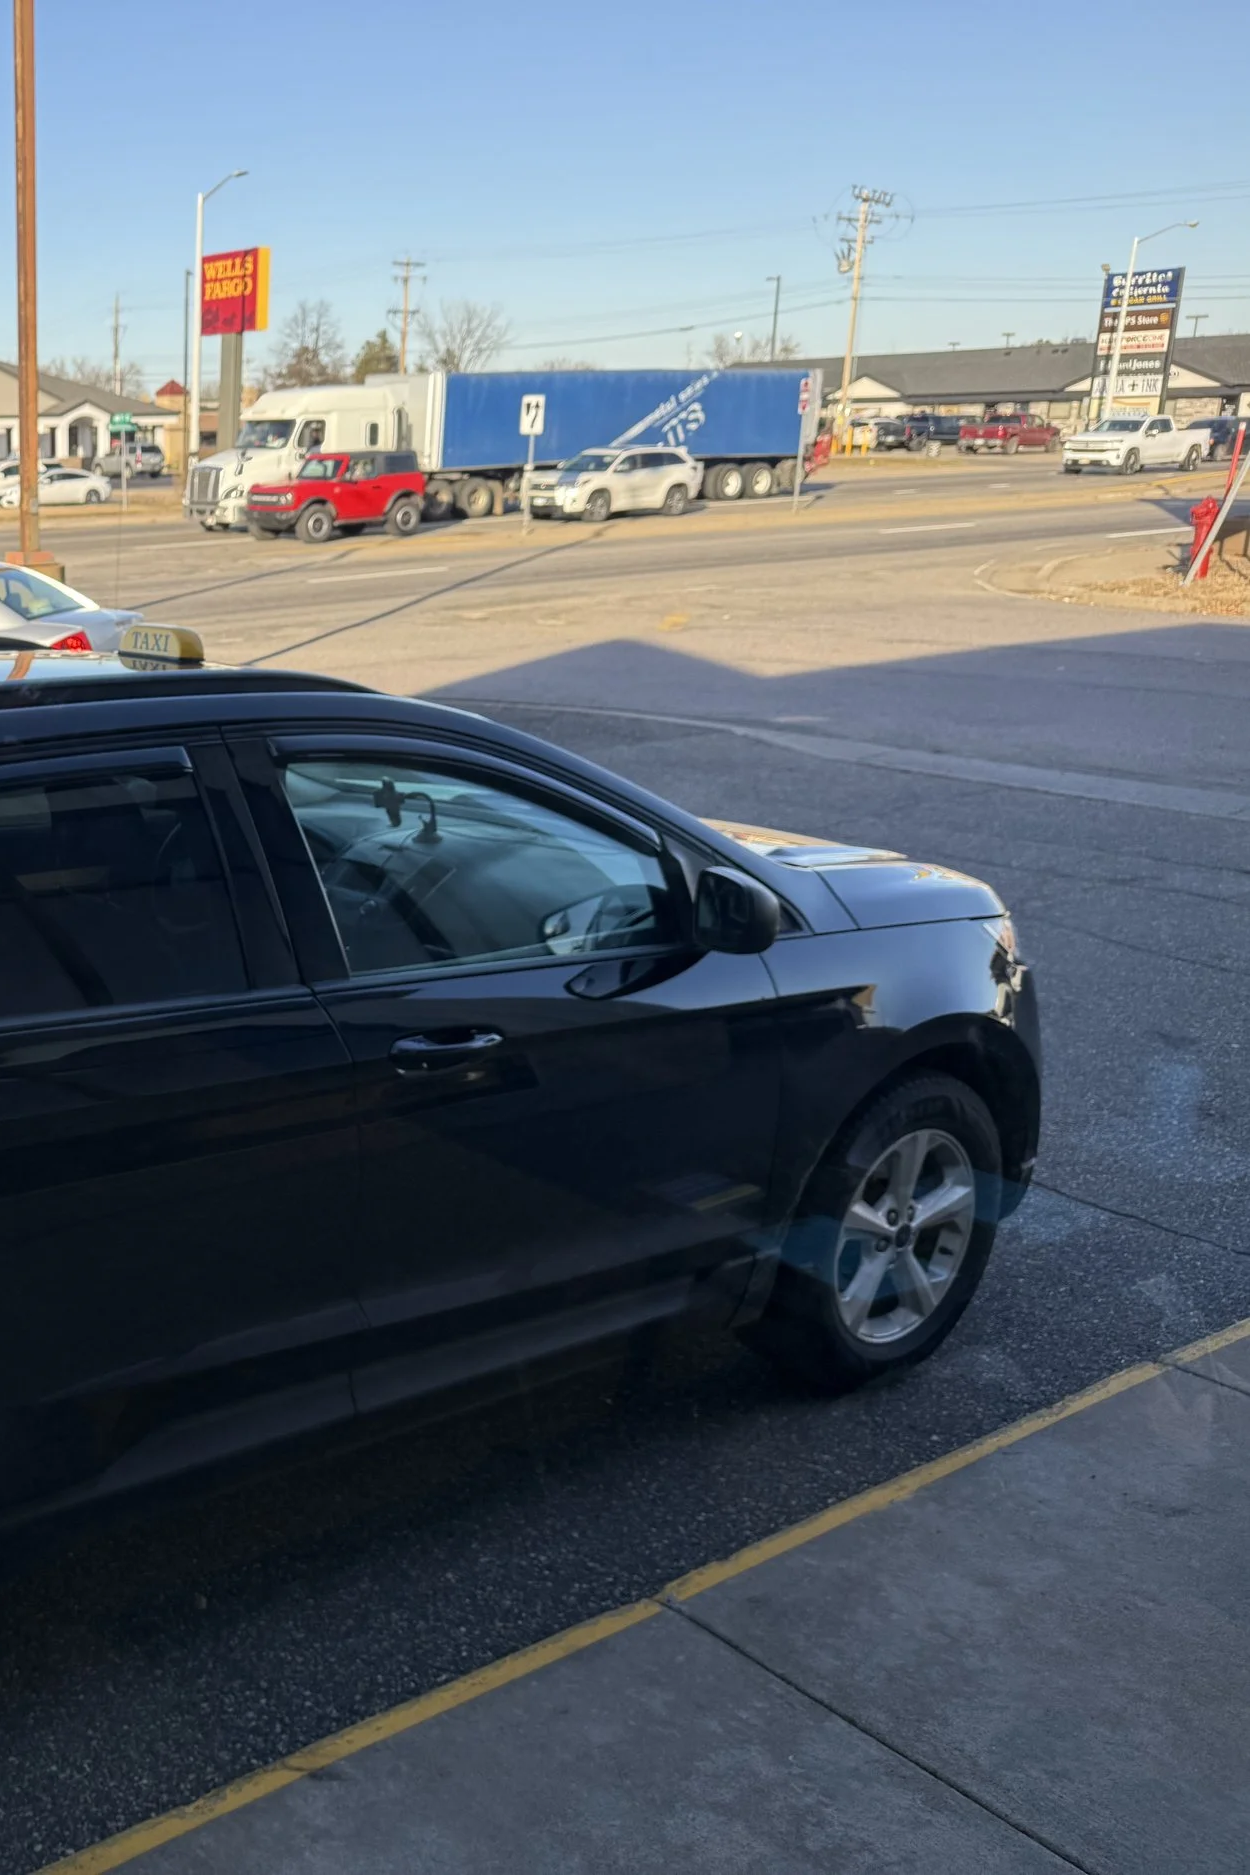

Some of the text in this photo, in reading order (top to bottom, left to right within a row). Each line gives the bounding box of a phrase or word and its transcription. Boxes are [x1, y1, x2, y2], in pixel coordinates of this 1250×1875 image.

[204, 255, 254, 280] WELLS
[204, 276, 253, 301] FARGO
[1137, 314, 1159, 325] Store
[1131, 358, 1161, 370] Jones
[133, 631, 170, 652] TAXI
